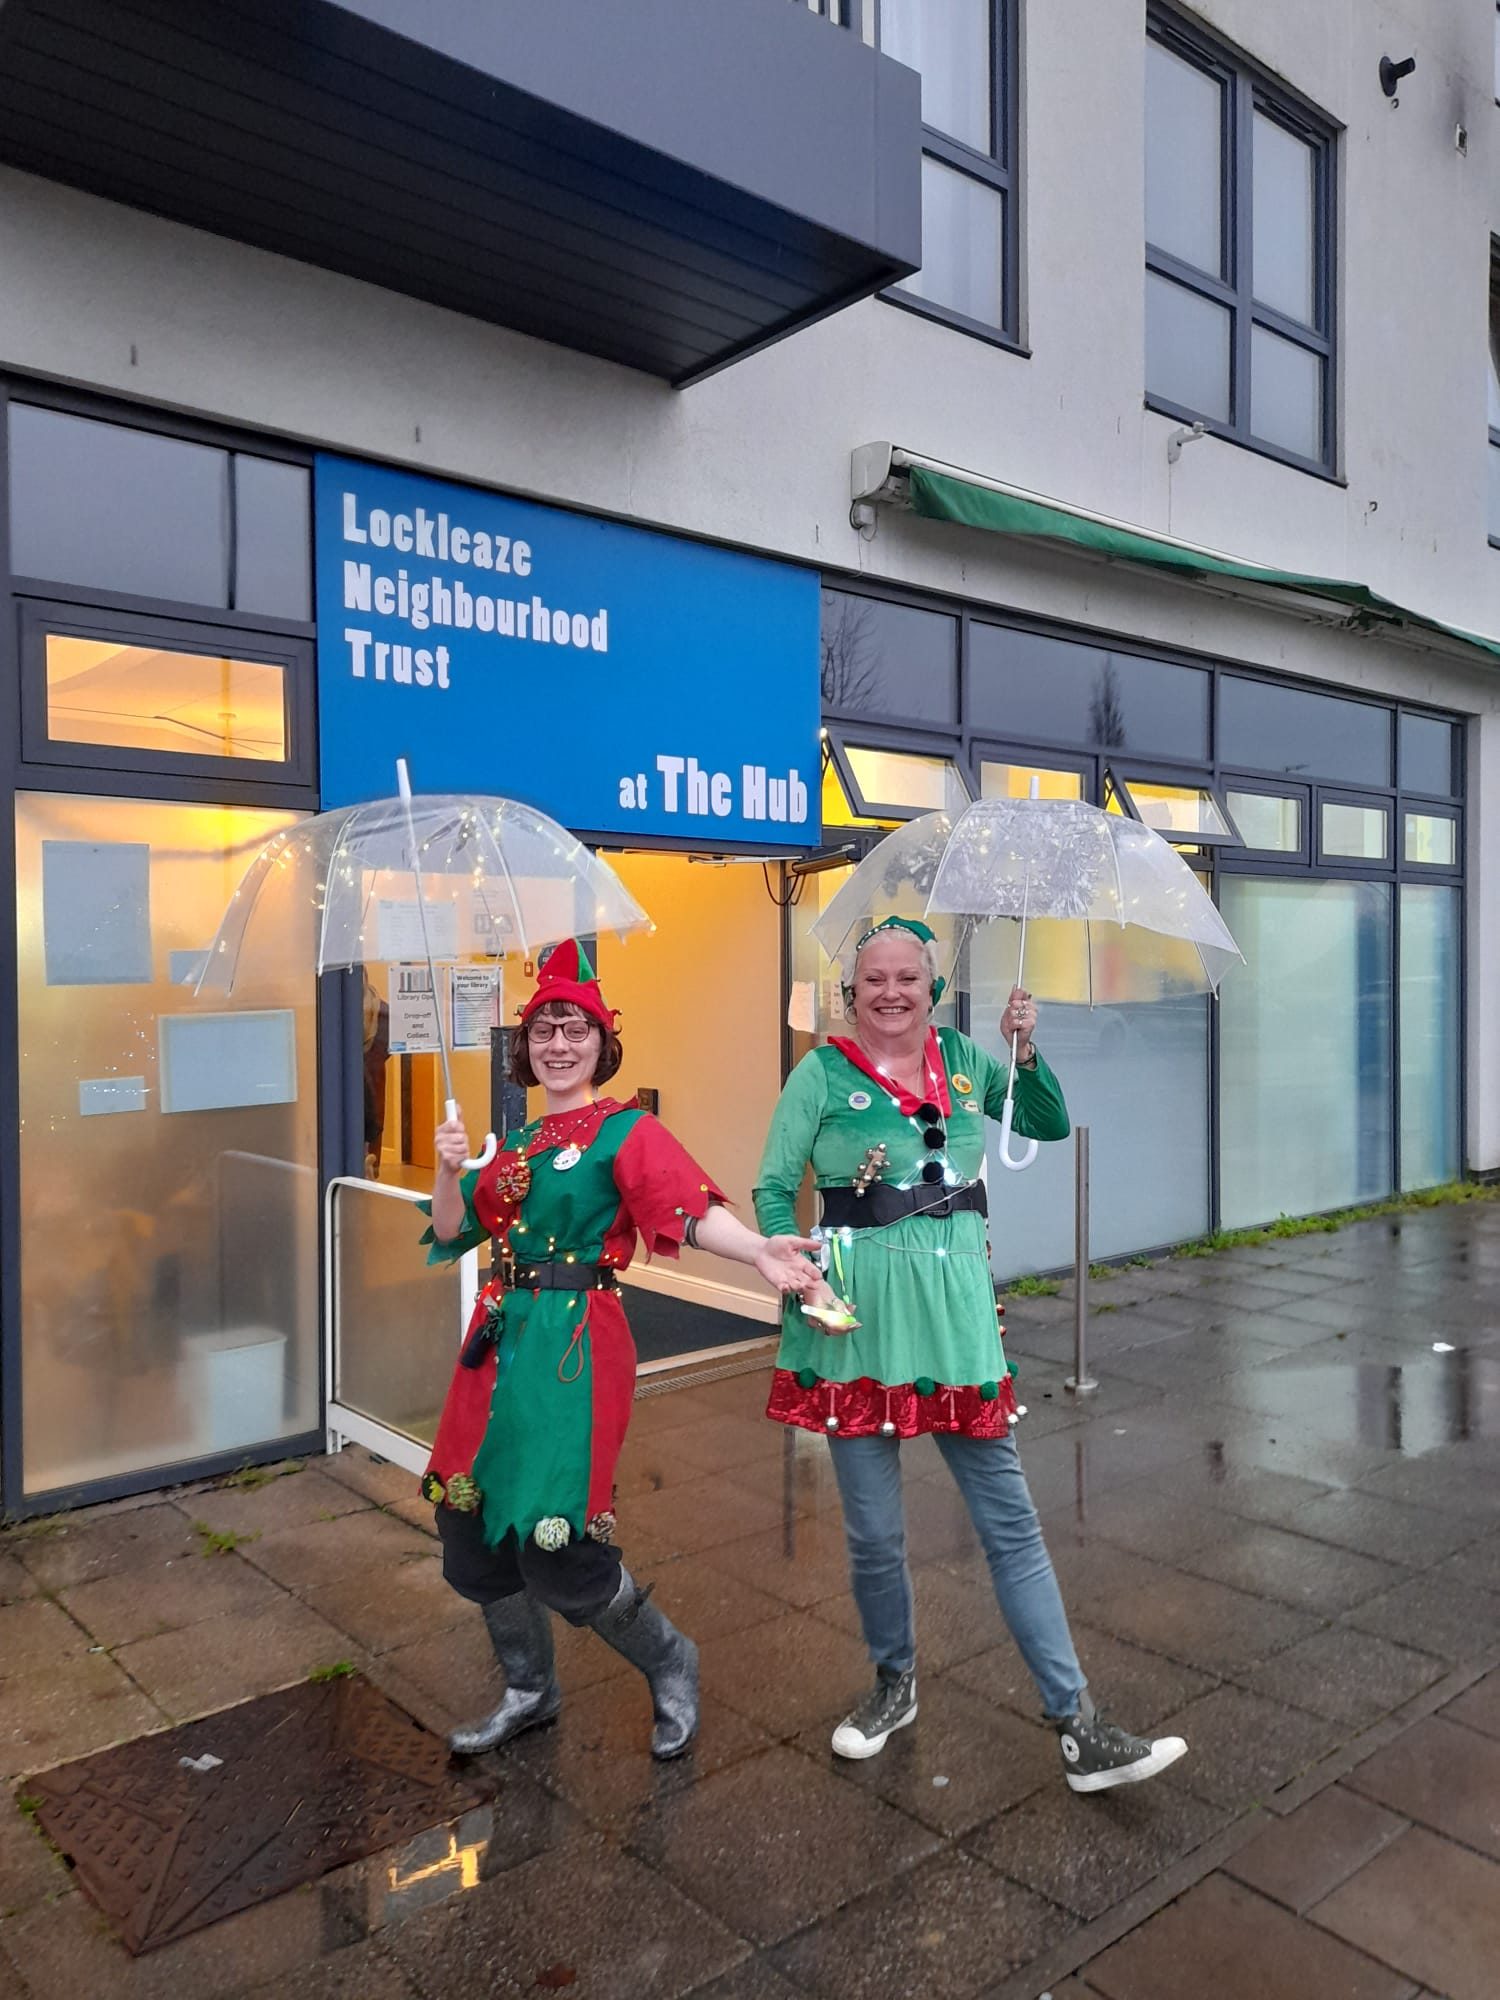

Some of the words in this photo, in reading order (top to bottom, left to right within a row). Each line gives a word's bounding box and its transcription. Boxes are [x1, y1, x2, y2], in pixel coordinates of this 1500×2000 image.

[343, 493, 532, 577] Lockleaze
[344, 561, 608, 653] Neighbourhood
[344, 629, 450, 689] Trust
[619, 773, 648, 810] at
[656, 755, 732, 817] The
[742, 765, 808, 824] Hub
[397, 994, 420, 1002] Library
